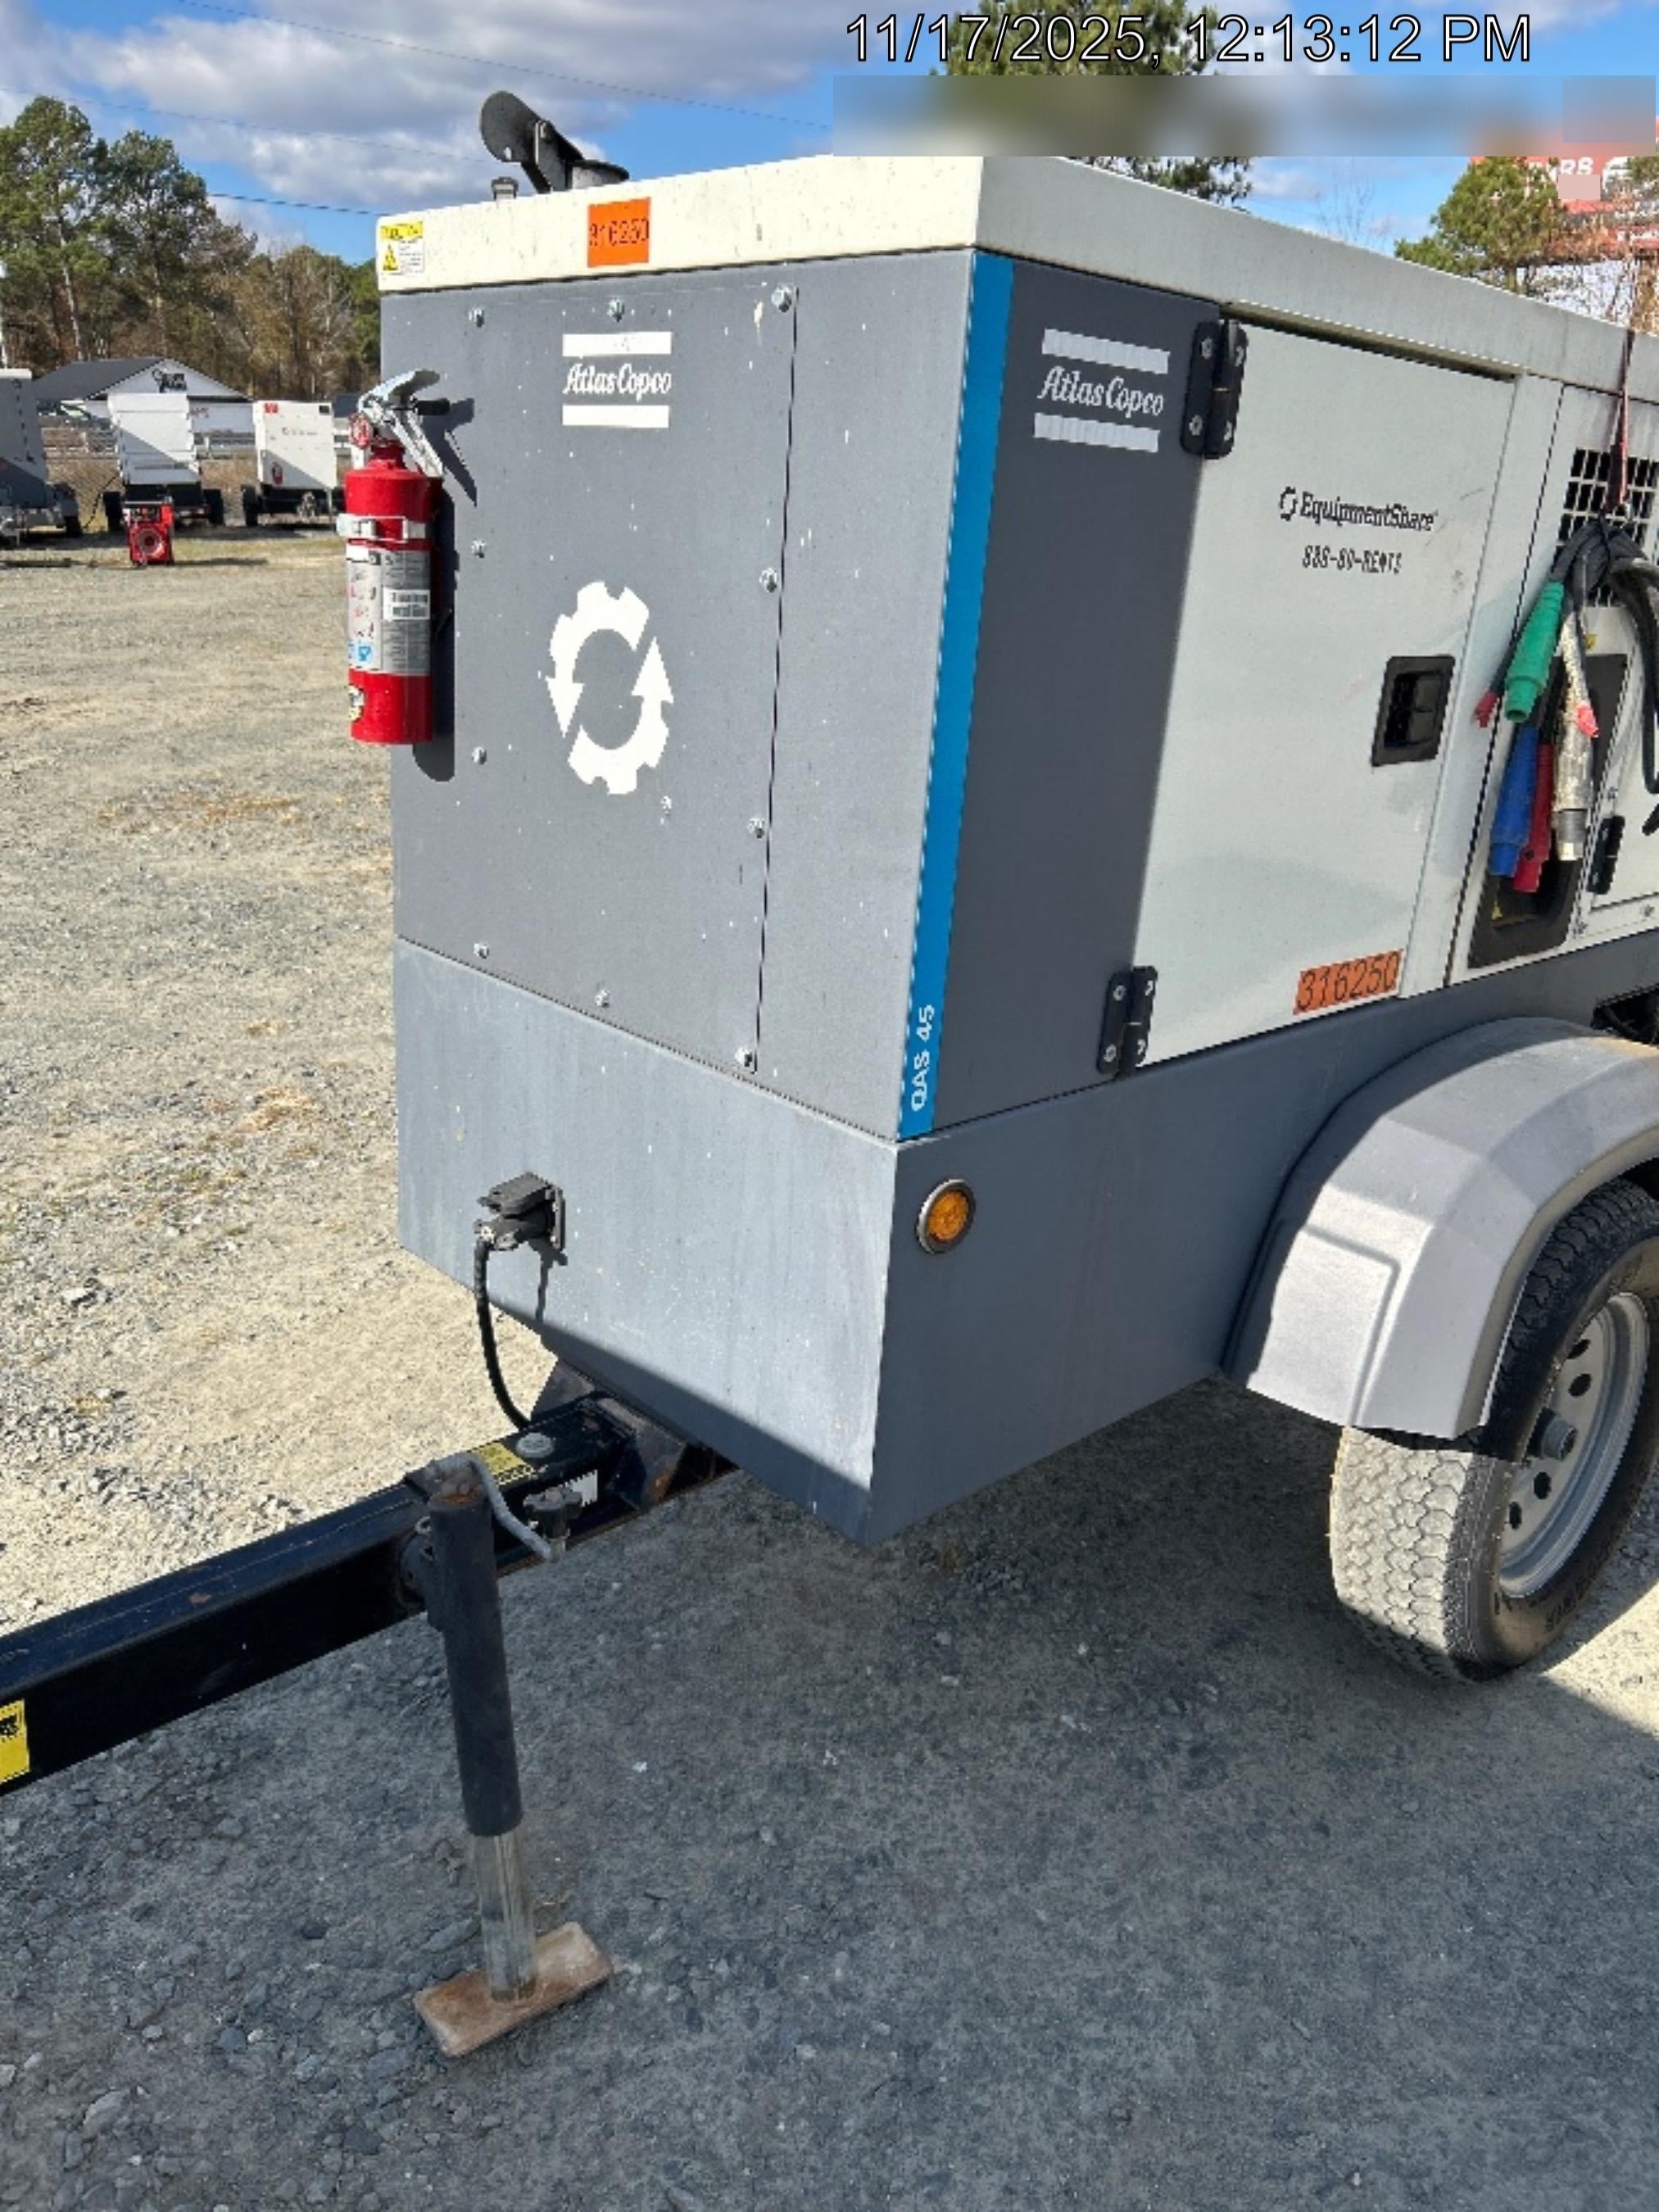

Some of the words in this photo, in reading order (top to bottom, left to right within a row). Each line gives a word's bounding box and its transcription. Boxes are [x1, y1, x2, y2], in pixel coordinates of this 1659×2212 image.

[563, 363, 617, 394] Atlas
[618, 363, 672, 402] Copco
[1036, 365, 1104, 406] Atlas
[1106, 376, 1163, 418] Copco
[1300, 492, 1434, 531] EquipmentShare
[1297, 951, 1401, 1011] 316250
[916, 1004, 936, 1042] 45
[911, 1049, 931, 1112] QAS
